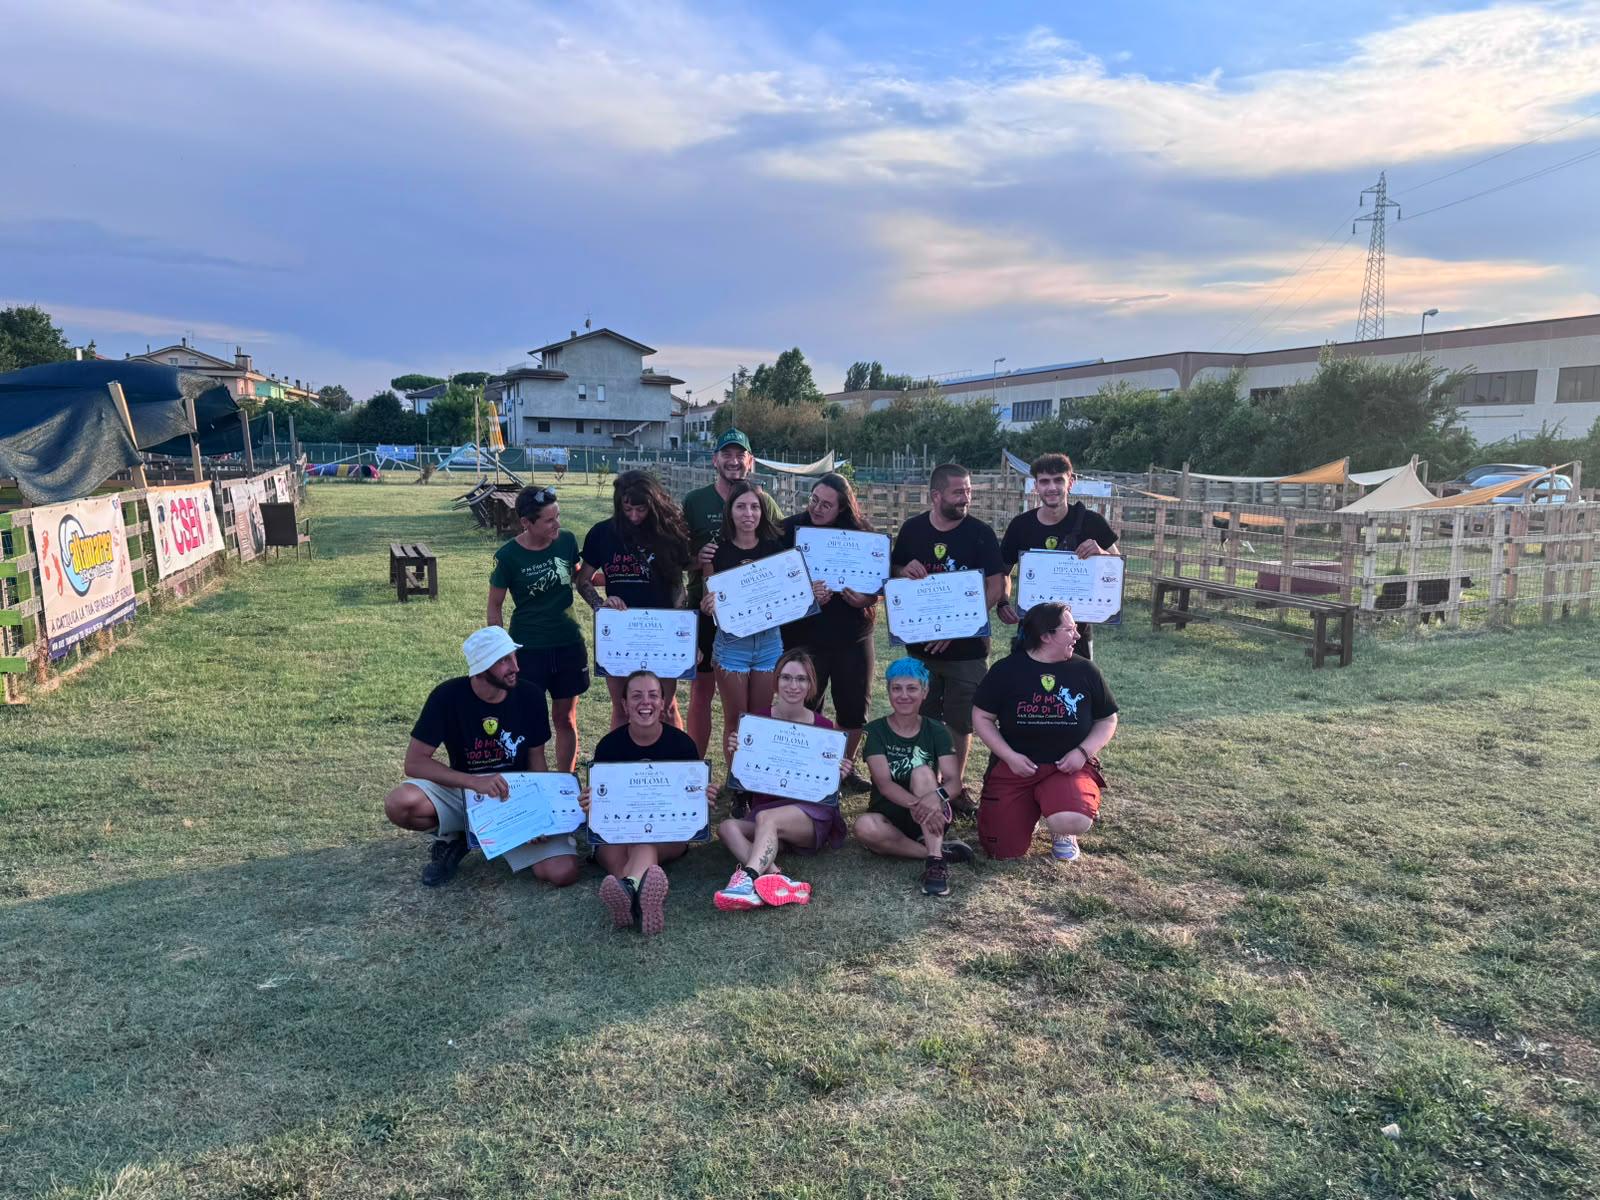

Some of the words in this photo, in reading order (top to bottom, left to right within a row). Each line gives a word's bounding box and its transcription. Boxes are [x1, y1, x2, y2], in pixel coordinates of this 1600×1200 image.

[170, 497, 205, 555] CSEN
[827, 540, 859, 548] DIPLOMA
[740, 570, 774, 586] DIPLOMA
[917, 585, 951, 594] DIPLOMA
[628, 621, 663, 629] DIPLOMA
[1032, 692, 1042, 704] IO
[1044, 694, 1056, 704] MI
[1017, 700, 1039, 715] FIDO
[1041, 705, 1051, 714] DI
[1054, 703, 1066, 716] TE
[773, 734, 810, 747] DIPLOMA
[629, 777, 670, 785] DIPLOMA
